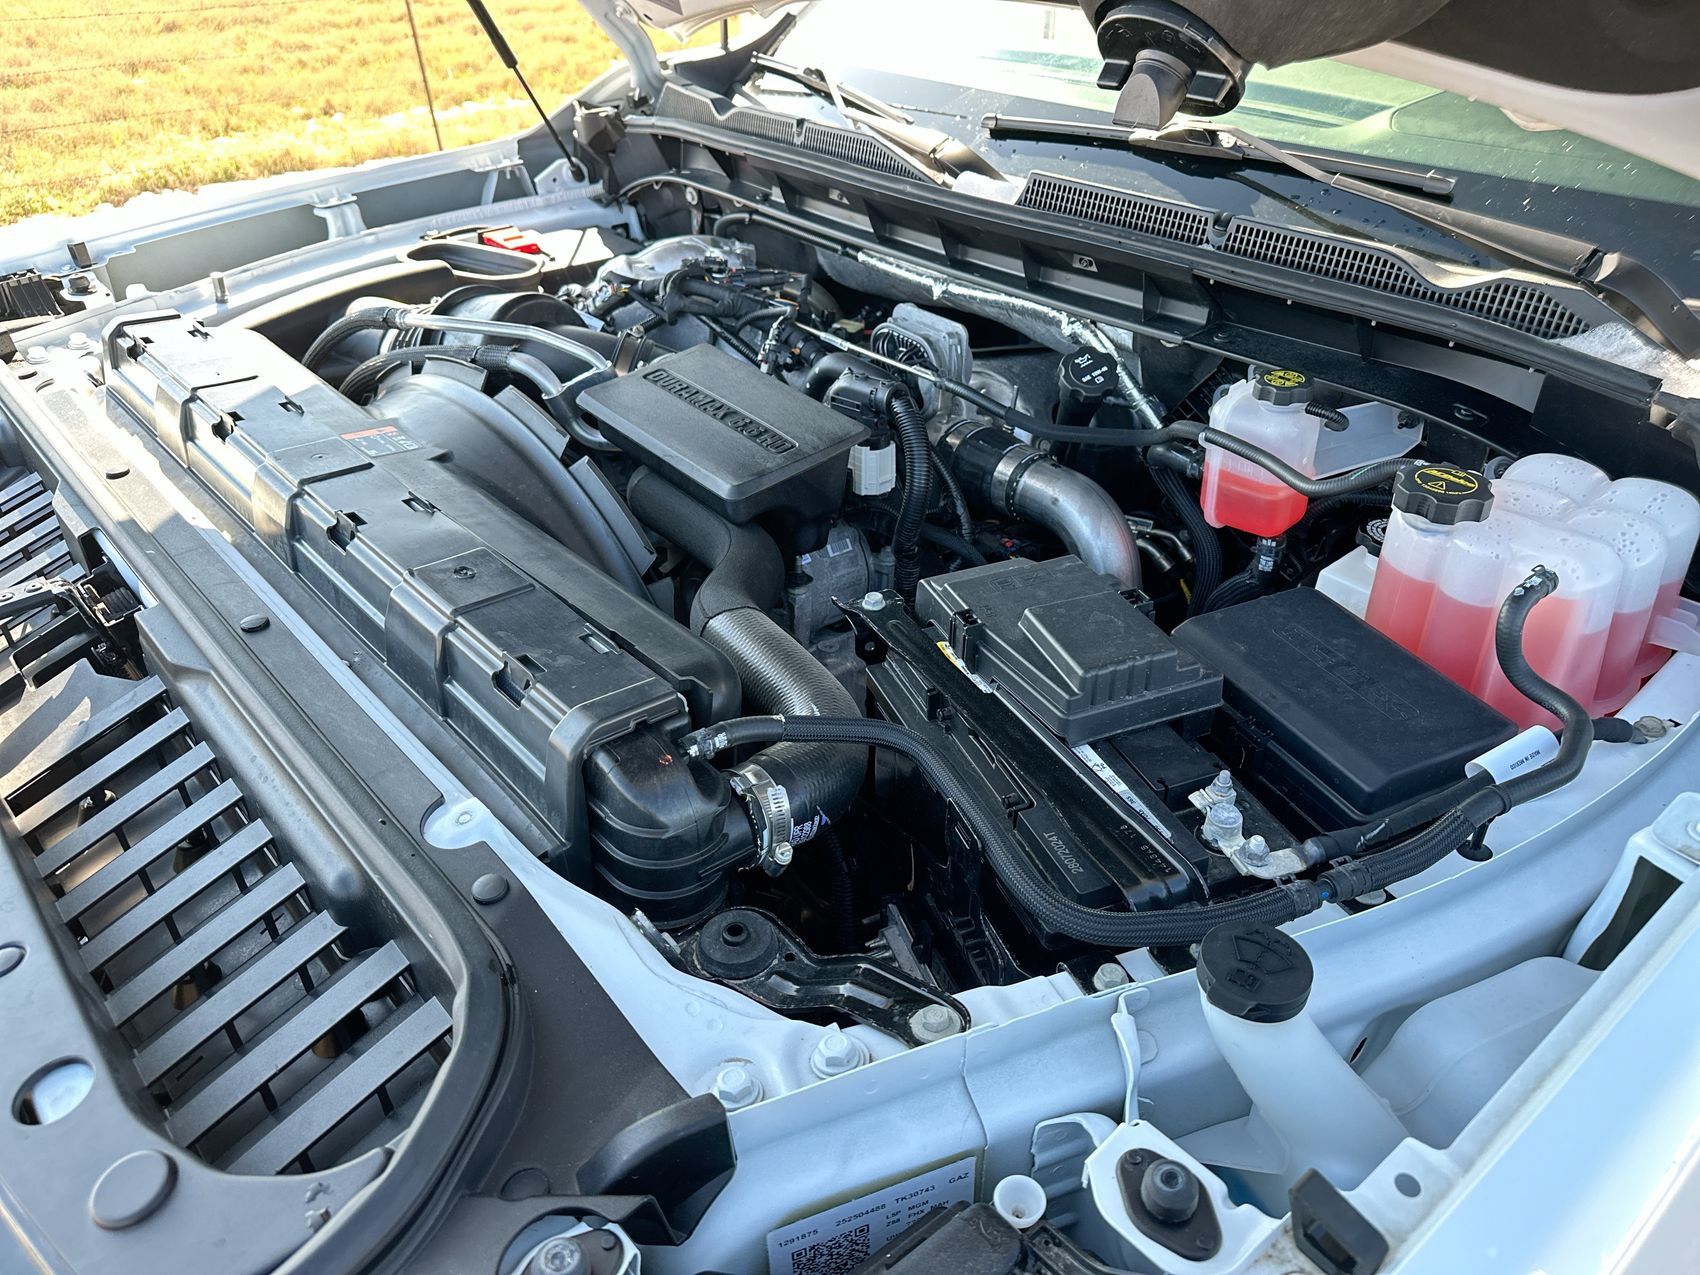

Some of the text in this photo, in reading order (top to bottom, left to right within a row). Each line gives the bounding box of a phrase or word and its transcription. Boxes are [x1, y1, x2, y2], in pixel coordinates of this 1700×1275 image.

[652, 370, 793, 453] DURAMAX 6.6 HD
[1510, 759, 1525, 770] MEXICO
[1529, 749, 1540, 759] MADE
[1043, 831, 1085, 874] 28072024T
[778, 1229, 819, 1248] 1291875
[836, 1204, 886, 1226] 252504488
[895, 1185, 936, 1204] TK30743
[948, 1172, 970, 1184] GAZ
[907, 1199, 929, 1211] MGM
